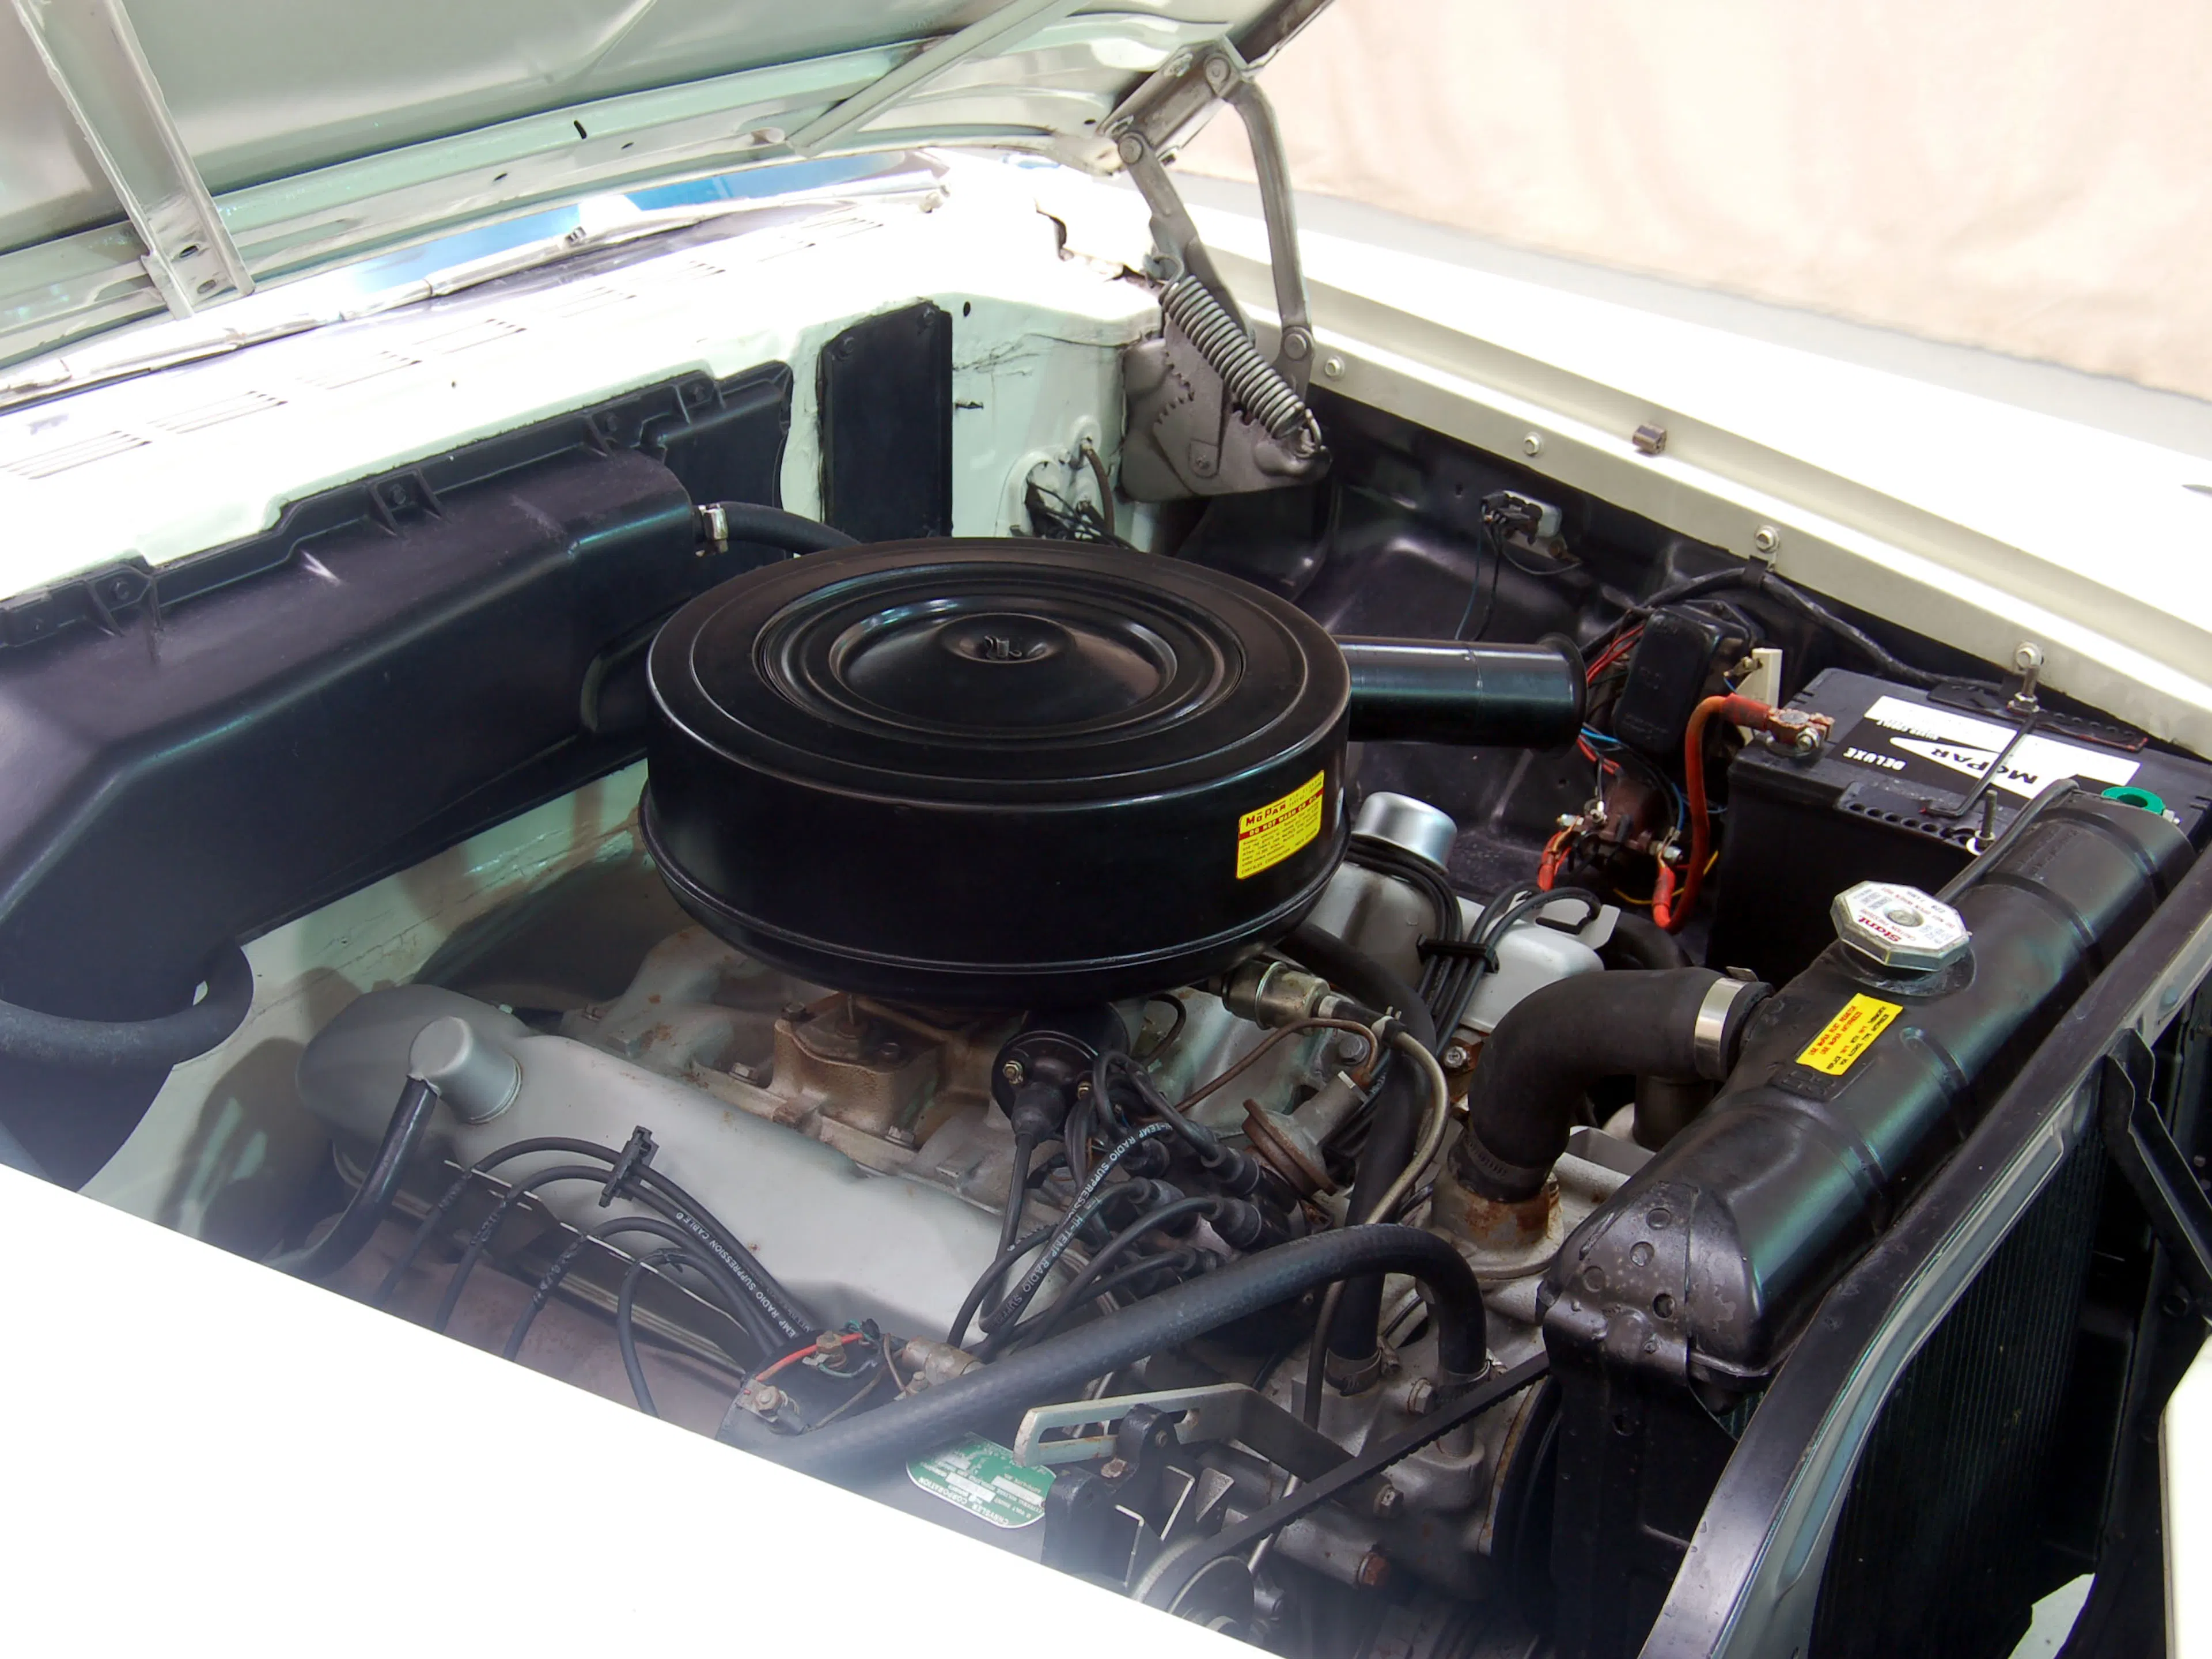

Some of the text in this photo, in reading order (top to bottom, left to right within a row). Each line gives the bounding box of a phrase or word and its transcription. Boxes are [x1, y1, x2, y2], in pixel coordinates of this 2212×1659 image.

[1843, 746, 1907, 771] DELUXE
[1859, 916, 1902, 942] Stant
[1109, 1135, 1136, 1161] RADIO
[1048, 1215, 1084, 1259] HI-TEMP
[709, 1239, 756, 1291] SUPPRESSION
[1022, 1259, 1050, 1293] RADIO
[755, 1291, 779, 1319] RADIO
